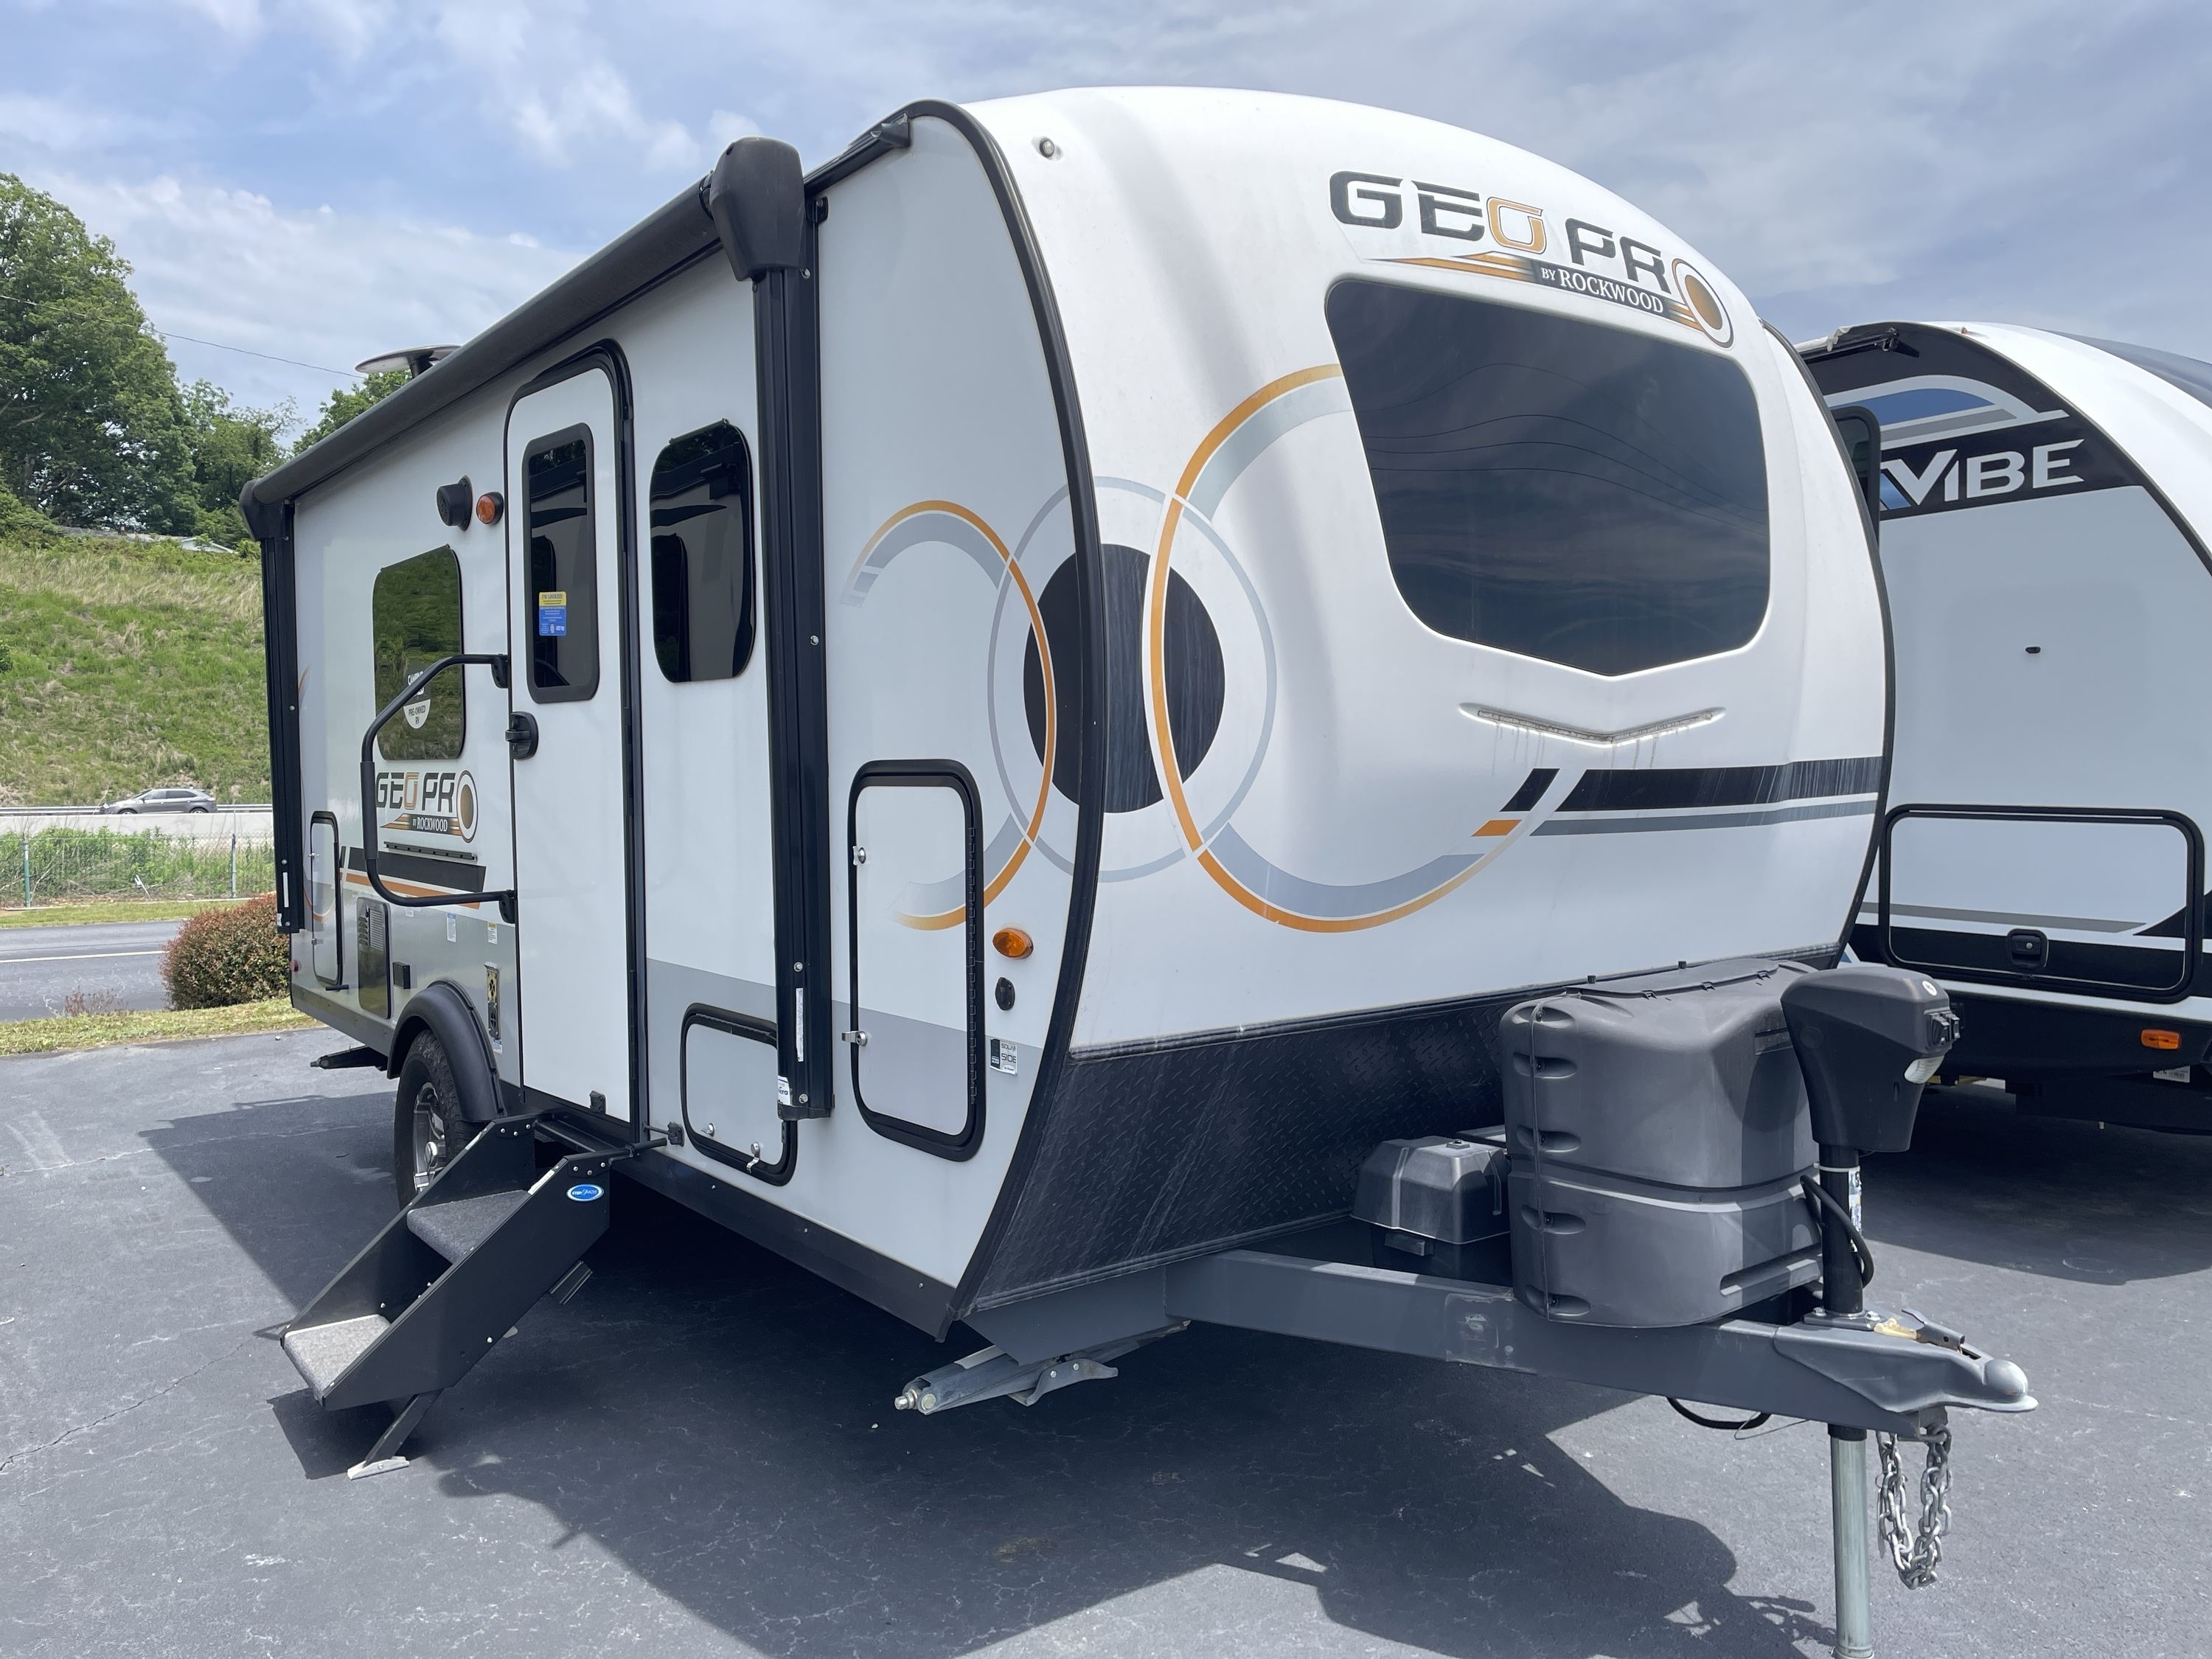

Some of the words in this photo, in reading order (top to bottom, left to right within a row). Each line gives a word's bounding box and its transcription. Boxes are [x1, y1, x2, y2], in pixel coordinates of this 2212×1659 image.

[1329, 170, 1547, 254] GEO
[1565, 218, 1735, 349] PRO
[1540, 267, 1557, 281] BY
[1557, 268, 1664, 313] ROCKWOOD
[1880, 438, 2085, 506] VIBE
[376, 772, 419, 810] GEO
[421, 770, 479, 844] PRO
[417, 816, 448, 832] ROCKWOOD
[1001, 1053, 1016, 1063] SIDE
